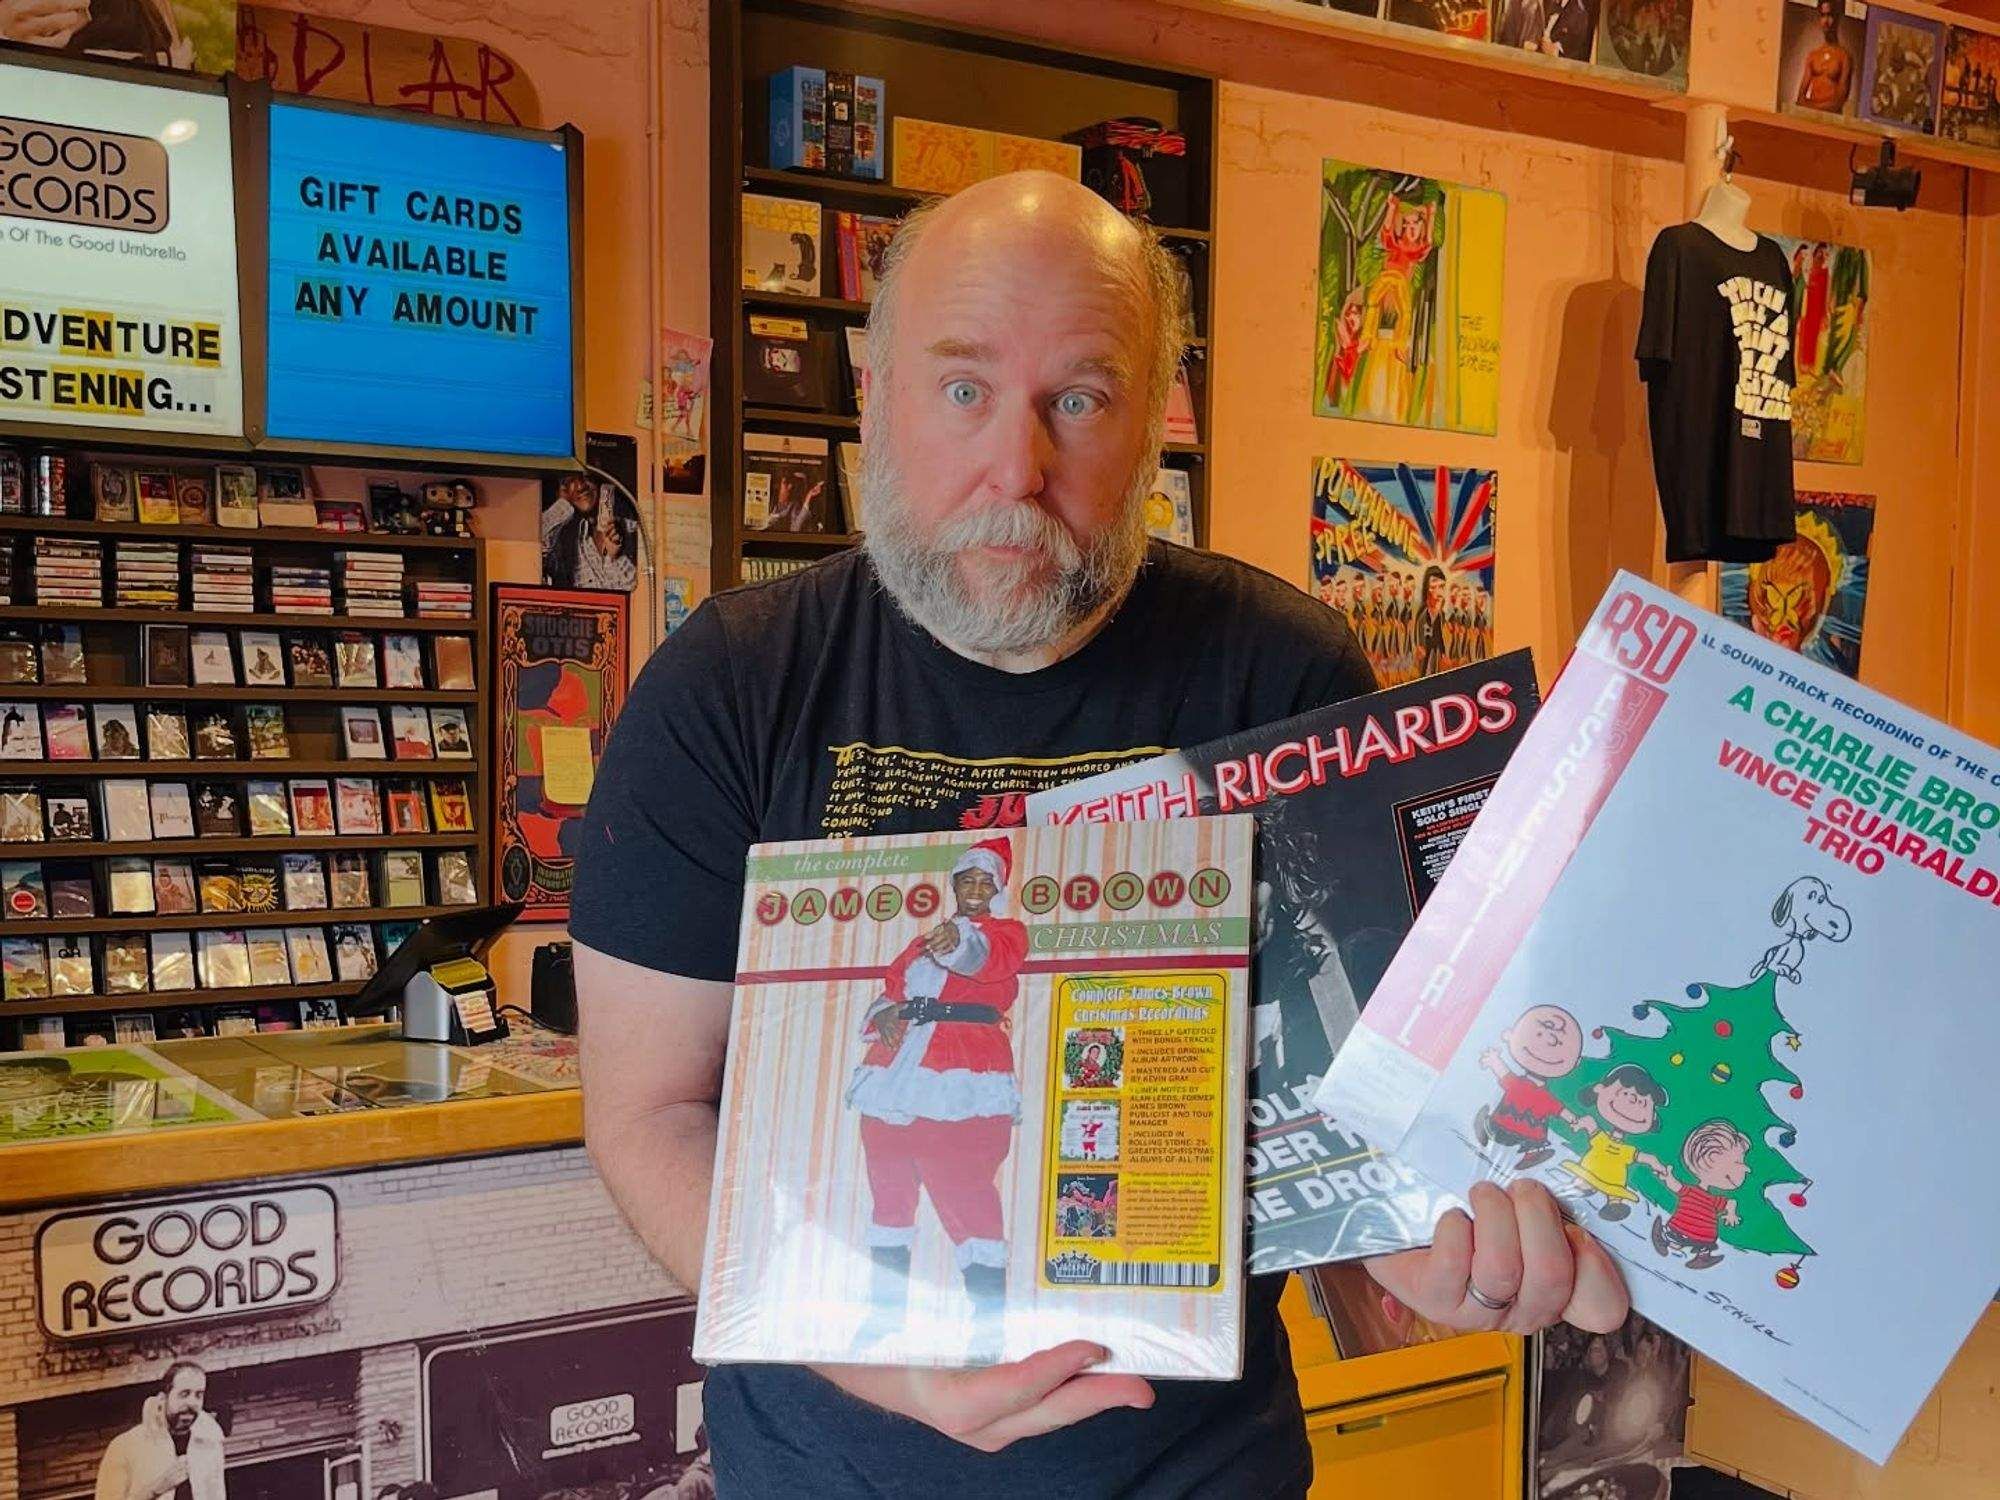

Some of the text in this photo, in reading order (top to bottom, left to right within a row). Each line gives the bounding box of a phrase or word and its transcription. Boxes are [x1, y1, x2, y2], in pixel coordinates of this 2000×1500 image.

[0, 168, 157, 225] CORDS
[299, 175, 523, 236] GIFT CARDS
[9, 226, 187, 262] Of The Good Umbrella
[317, 231, 508, 282] AVAILABLE
[294, 280, 540, 336] ANY AMOUNT
[1592, 590, 1698, 685] RSD
[1720, 642, 1775, 677] SOUND
[1777, 670, 1831, 704] TRACK
[1831, 697, 1926, 750] RECORDING
[1927, 744, 1953, 761] OF
[1954, 754, 1989, 781] THE
[1214, 680, 1517, 812] RICHARDS
[1727, 684, 1756, 714] A
[1763, 699, 1919, 790] CHARLIE
[869, 781, 898, 793] THEY
[901, 783, 932, 797] CAN'T
[884, 769, 941, 782] BLASPHEMY
[943, 777, 989, 790] AGAINST
[970, 767, 1006, 778] AFTER
[1009, 767, 1059, 778] NINETEEN
[1060, 763, 1111, 775] HUNDRED
[1717, 738, 1824, 811] VINCE
[825, 802, 894, 817] THE SECOND
[829, 793, 841, 802] IT
[845, 791, 866, 802] ANY
[1411, 798, 1456, 820] KEITH'S
[1773, 738, 1982, 856] CHRISTMAS
[1416, 811, 1447, 828] SOLO
[794, 850, 911, 877] the complete
[1801, 816, 1886, 876] TRIO
[759, 886, 937, 923] JAMES
[1028, 871, 1227, 910] BROWN
[1033, 920, 1224, 951] CHRISTMAS
[93, 1200, 287, 1265] GOOD
[62, 1250, 319, 1332] RECORDS
[555, 1413, 632, 1440] RECORDS
[566, 1400, 620, 1422] GOOD
